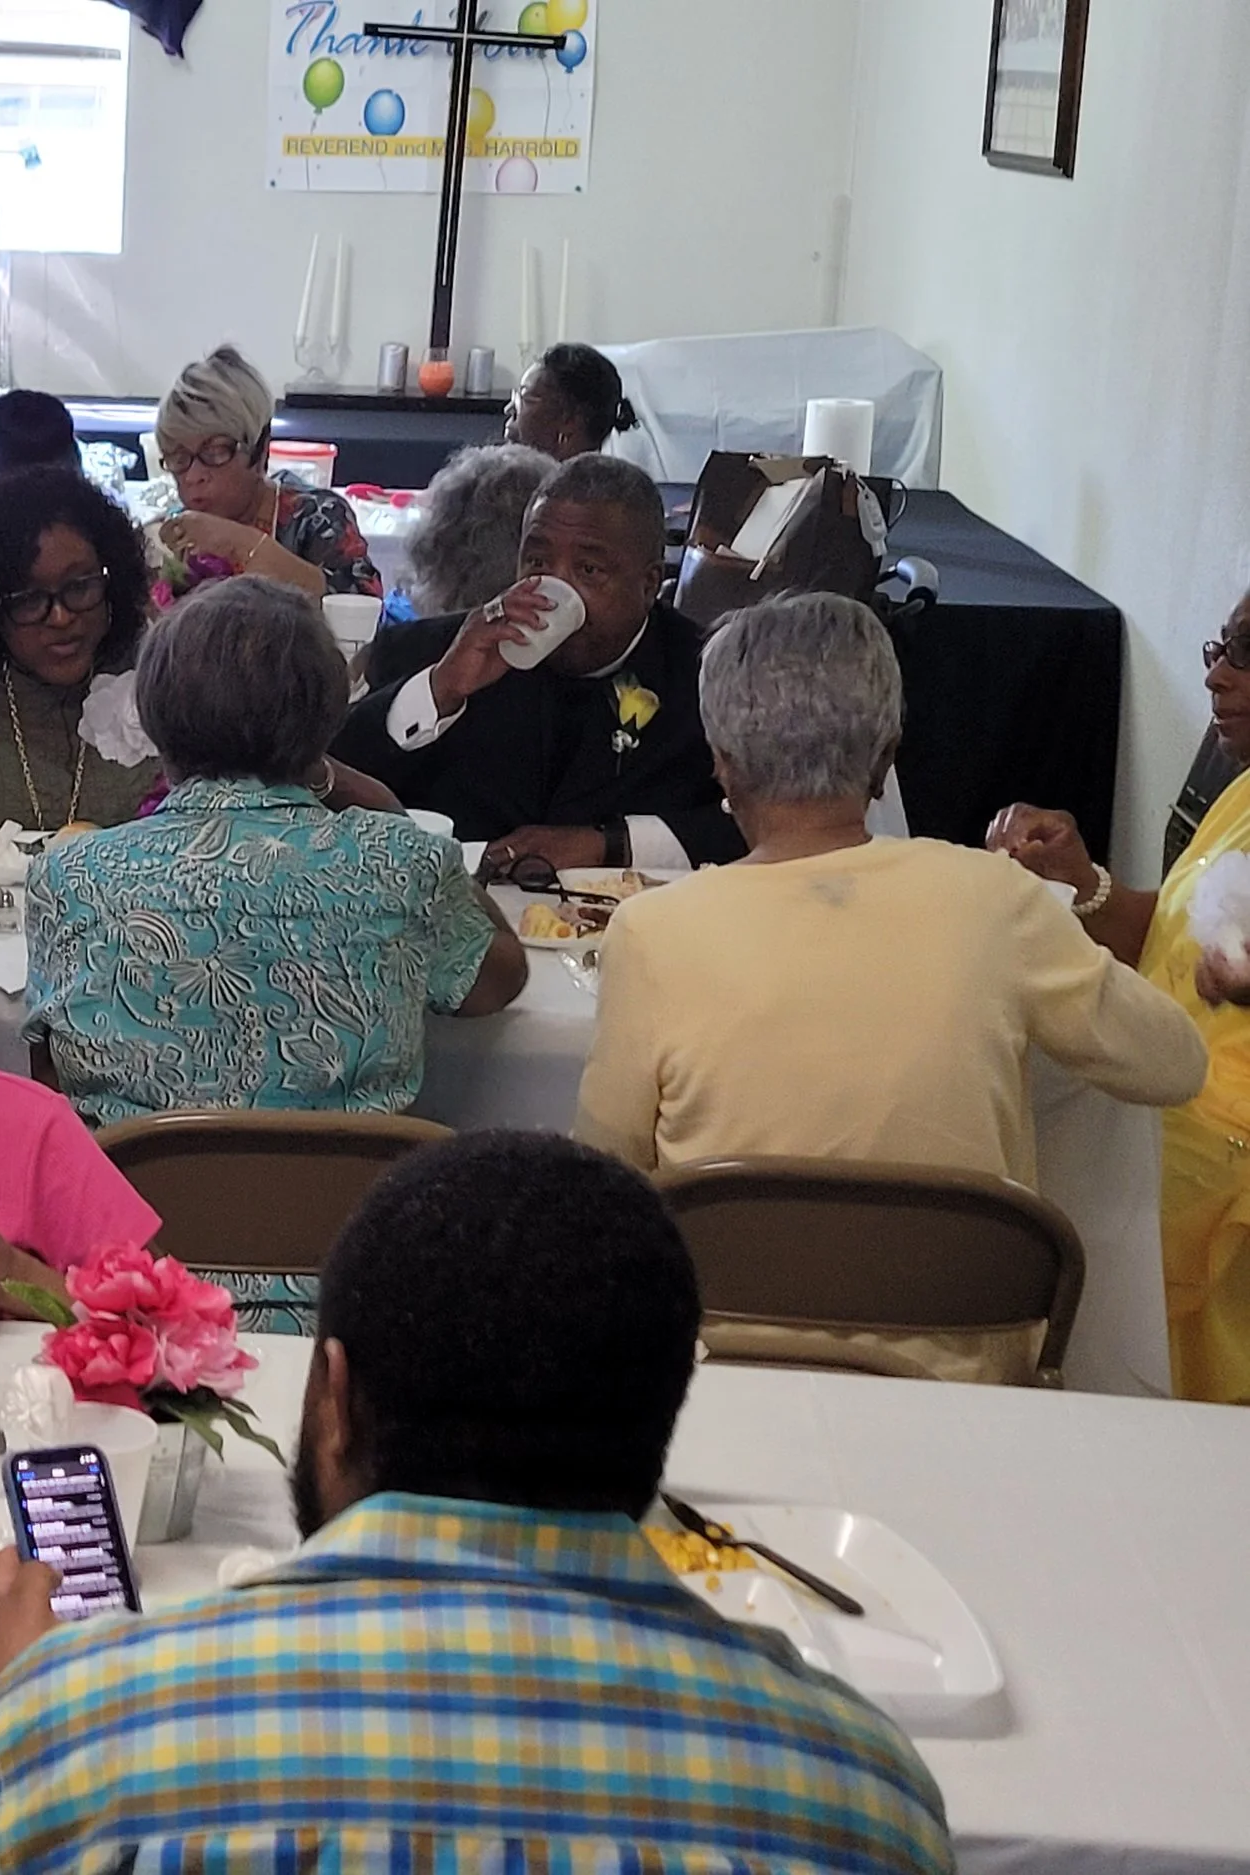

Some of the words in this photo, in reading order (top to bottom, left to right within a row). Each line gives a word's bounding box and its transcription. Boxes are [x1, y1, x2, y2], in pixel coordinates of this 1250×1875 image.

[286, 140, 388, 155] REVEREND
[395, 141, 427, 156] and
[485, 141, 578, 156] HARROLD
